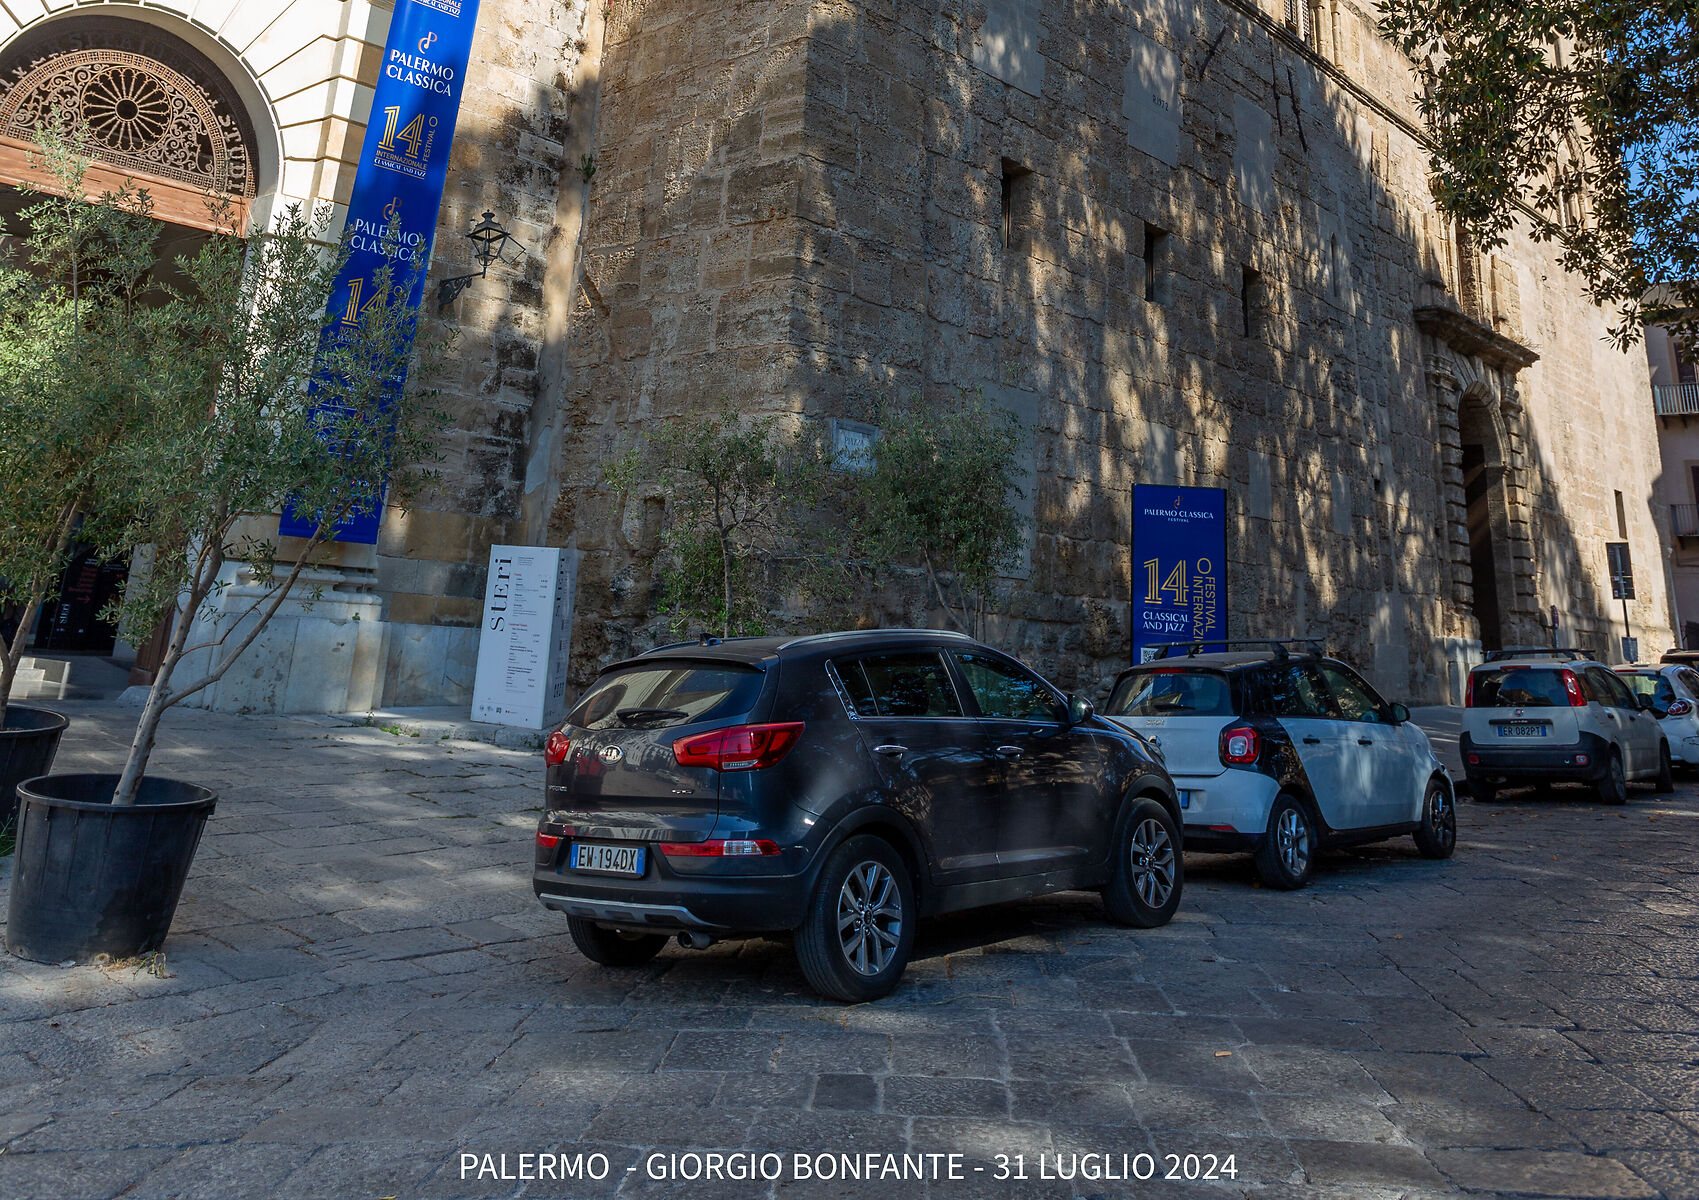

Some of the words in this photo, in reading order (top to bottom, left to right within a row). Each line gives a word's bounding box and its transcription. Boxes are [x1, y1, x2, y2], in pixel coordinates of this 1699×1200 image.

[390, 48, 454, 81] PALERMO
[386, 64, 451, 97] CLASSICA
[217, 114, 246, 193] STUDI
[422, 129, 436, 162] FESTIVAL
[375, 150, 428, 170] INTERNAZIONALE
[354, 218, 420, 247] PALEMO
[1144, 508, 1178, 518] PALERMO
[1178, 510, 1214, 519] CLASSICA
[1142, 611, 1190, 623] CLASSICAL
[1204, 576, 1216, 632] FESTIVAL
[1142, 621, 1163, 631] AND
[1164, 622, 1185, 633] JAZZ
[1503, 726, 1513, 736] ER
[578, 846, 594, 868] EW
[599, 847, 637, 872] 194DX
